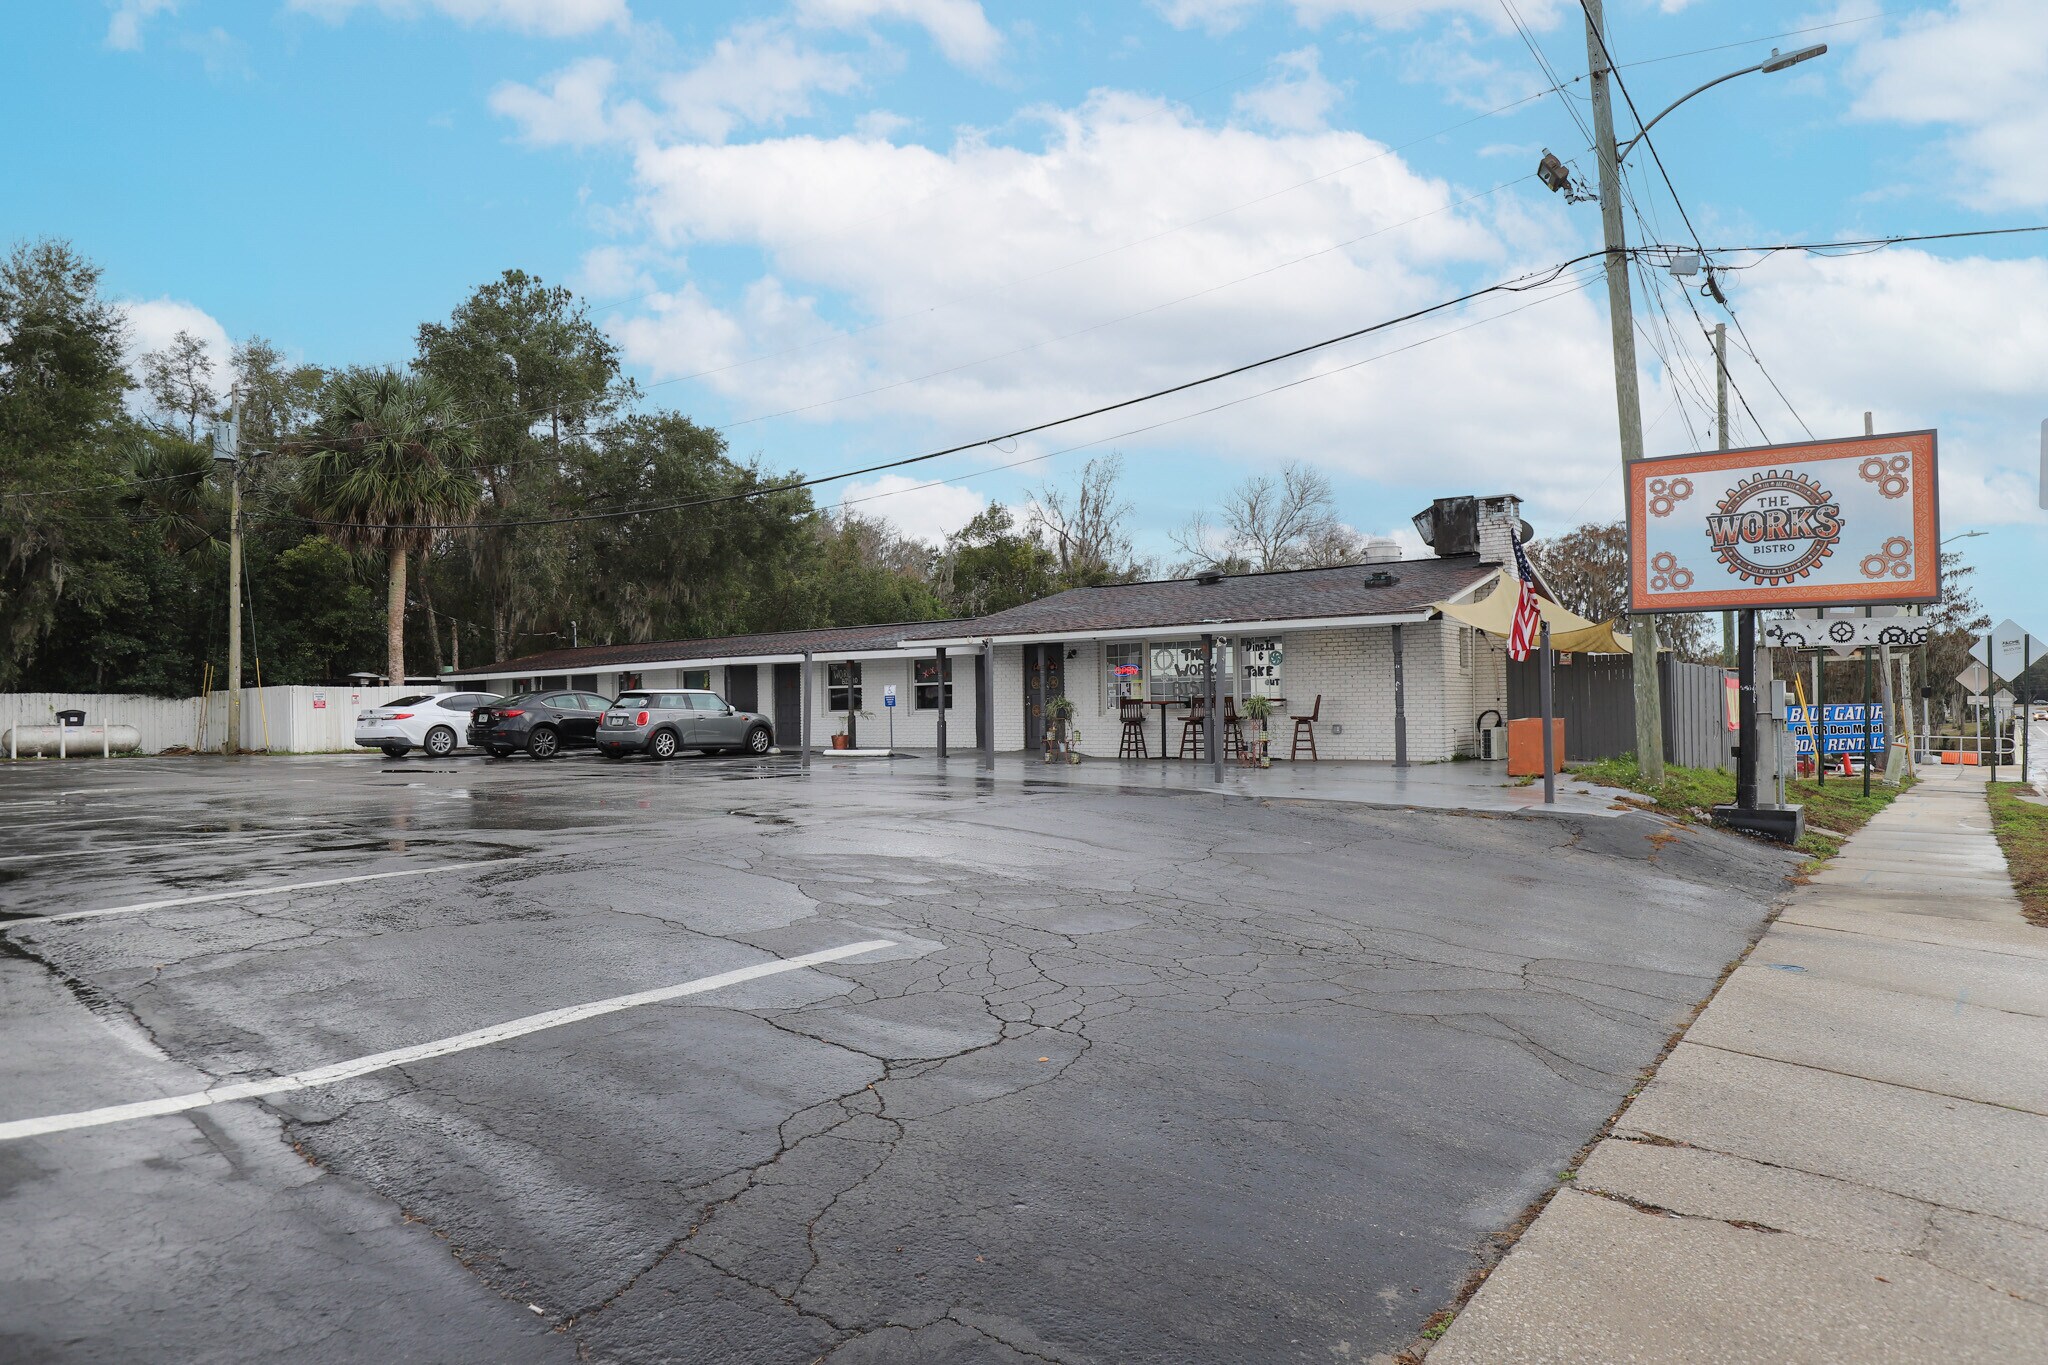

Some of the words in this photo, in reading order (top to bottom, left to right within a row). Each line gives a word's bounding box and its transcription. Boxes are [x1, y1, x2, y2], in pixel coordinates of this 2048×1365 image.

[1757, 495, 1789, 508] THE
[1706, 504, 1840, 547] WORKS
[1753, 543, 1795, 554] BISTRO
[1114, 665, 1139, 675] OPEN
[1830, 724, 1851, 735] Den
